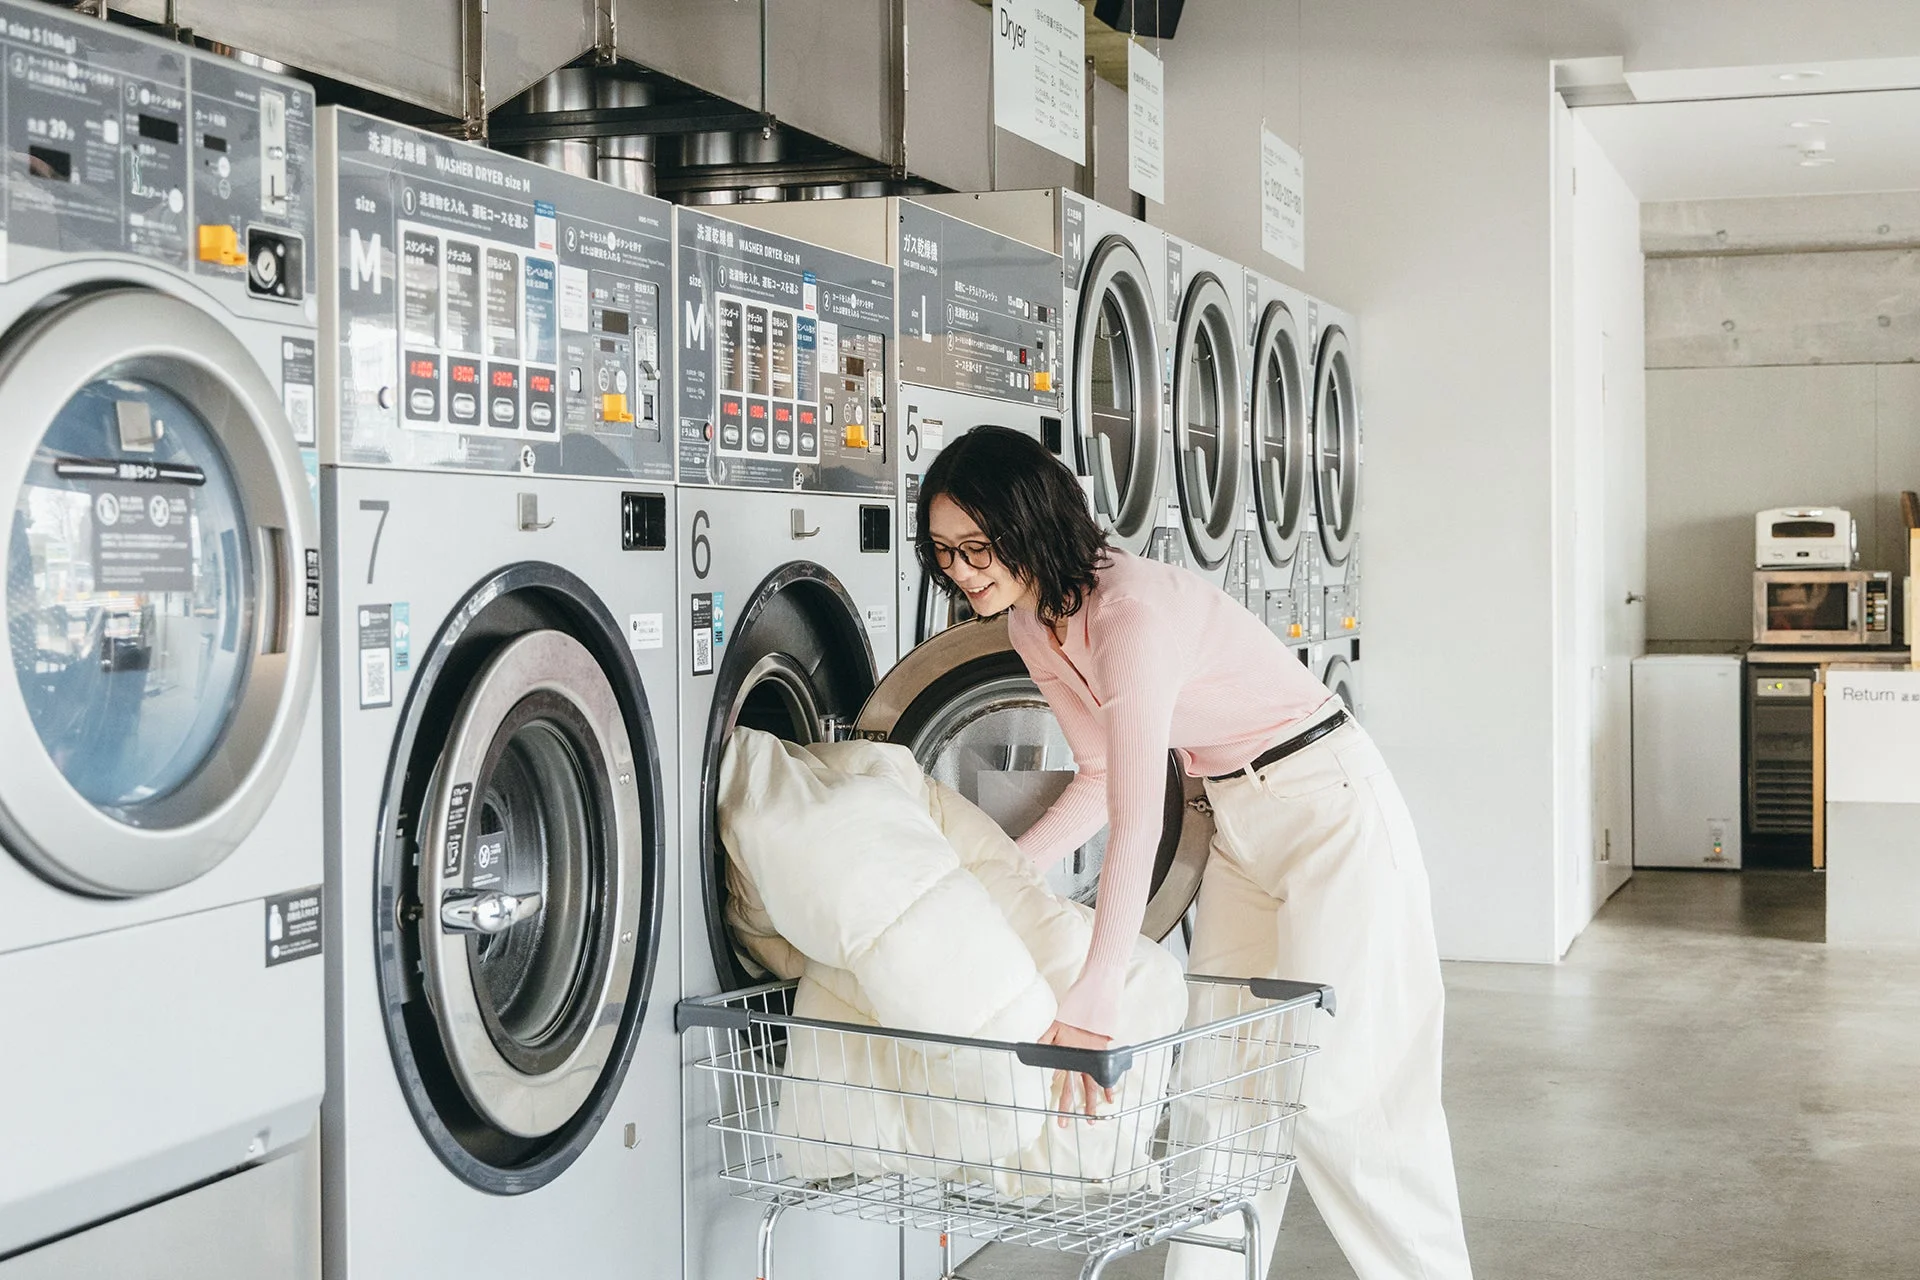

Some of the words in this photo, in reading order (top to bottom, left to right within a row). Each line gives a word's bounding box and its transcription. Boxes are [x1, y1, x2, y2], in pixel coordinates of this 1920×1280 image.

[32, 27, 40, 43] S
[1000, 8, 1026, 50] Dryer
[368, 131, 427, 166] 洗濯乾燥機
[435, 155, 474, 178] WASHER
[475, 165, 503, 184] DRYER
[505, 174, 522, 190] size
[523, 178, 531, 193] M
[355, 195, 376, 213] size
[350, 228, 382, 295] M
[739, 239, 763, 257] WASHER
[764, 246, 783, 260] DRYER
[783, 252, 794, 264] size
[795, 254, 801, 265] M
[903, 234, 938, 262] ガス乾燥機
[1073, 233, 1081, 260] M
[689, 274, 702, 288] size
[1173, 271, 1180, 296] M
[685, 300, 705, 350] M
[921, 295, 932, 343] L
[906, 405, 919, 462] 5
[359, 500, 390, 585] 7
[691, 509, 711, 580] 6
[1843, 687, 1895, 701] Return
